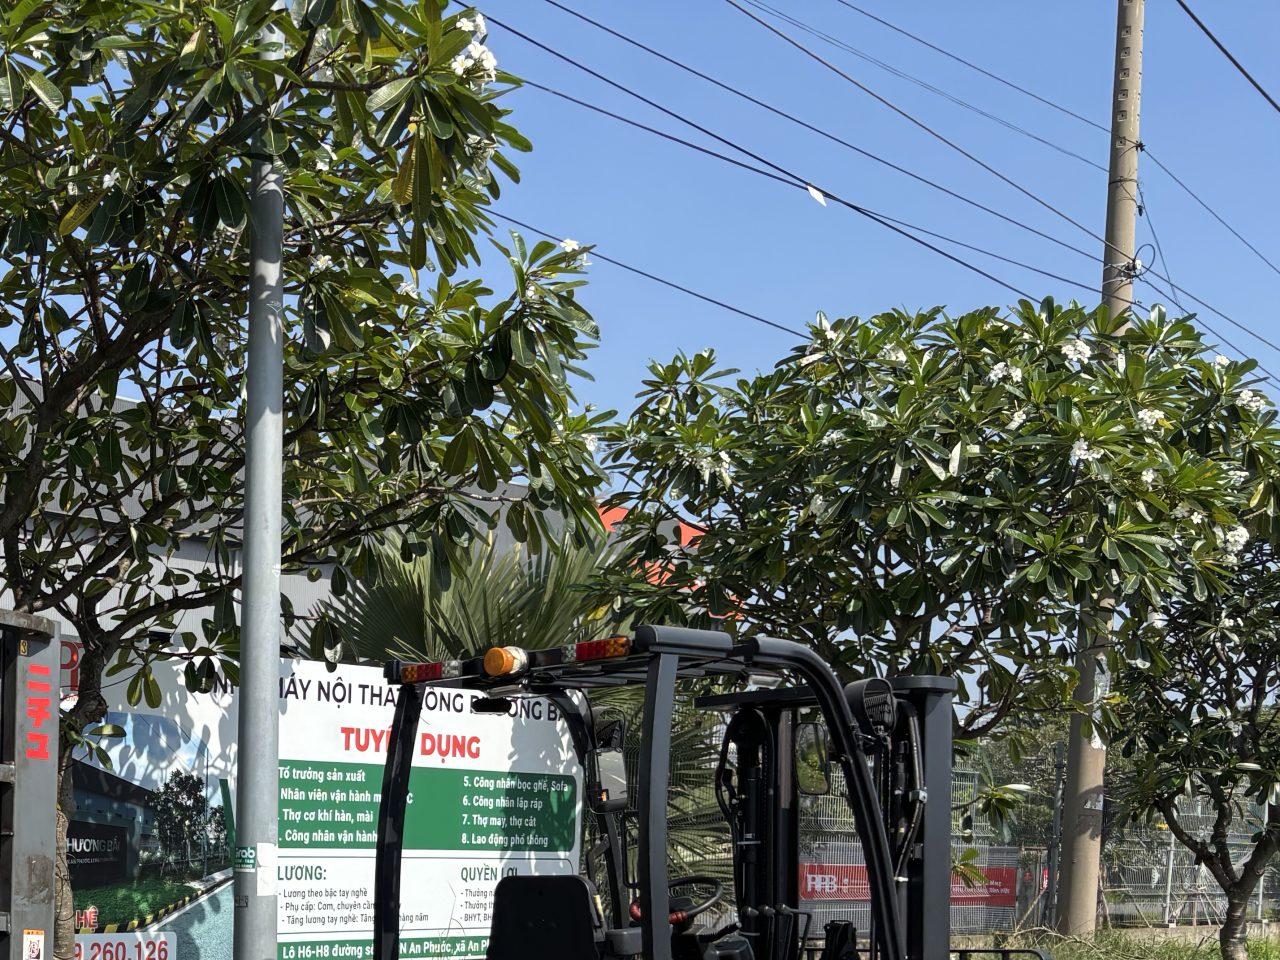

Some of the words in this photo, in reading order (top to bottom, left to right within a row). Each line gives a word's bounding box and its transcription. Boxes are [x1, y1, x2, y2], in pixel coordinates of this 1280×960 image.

[279, 672, 311, 700] ÁY
[317, 677, 352, 708] NỘI
[420, 686, 463, 713] ÔNG
[341, 725, 392, 752] TUY
[420, 732, 480, 764] DỤNG
[292, 766, 324, 783] trưởng
[326, 768, 343, 781] sản
[346, 769, 366, 782] xuất
[463, 776, 471, 787] 5.
[473, 777, 494, 791] Công
[496, 778, 515, 789] nhân
[551, 781, 568, 791] Sofa
[280, 787, 305, 800] Nhân
[308, 789, 327, 801] viên
[330, 789, 347, 804] vận
[349, 790, 371, 802] hành
[463, 795, 471, 806] 6.
[473, 796, 494, 809] Công
[495, 796, 514, 808] nhân
[282, 808, 301, 823] Thợ
[303, 811, 316, 821] cơ
[318, 809, 333, 821] khí
[335, 810, 354, 824] hàn,
[356, 810, 373, 822] mài
[462, 814, 470, 825] 7.
[472, 815, 489, 828] Thợ
[285, 829, 310, 845] Công
[312, 830, 335, 842] nhân
[337, 830, 353, 844] vận
[461, 833, 469, 844] 8.
[472, 833, 486, 844] Lao
[488, 834, 508, 847] động
[277, 864, 327, 881] LƯƠNG:
[461, 863, 498, 883] QUYỀN
[283, 888, 306, 900] Lương
[308, 888, 323, 898] theo
[339, 889, 350, 899] tay
[75, 905, 98, 932] HỆ
[328, 915, 338, 925] tay
[282, 945, 296, 959] Lô
[297, 944, 330, 958] H6-H8
[332, 943, 363, 959] đường
[409, 941, 421, 954] An
[467, 940, 479, 952] An
